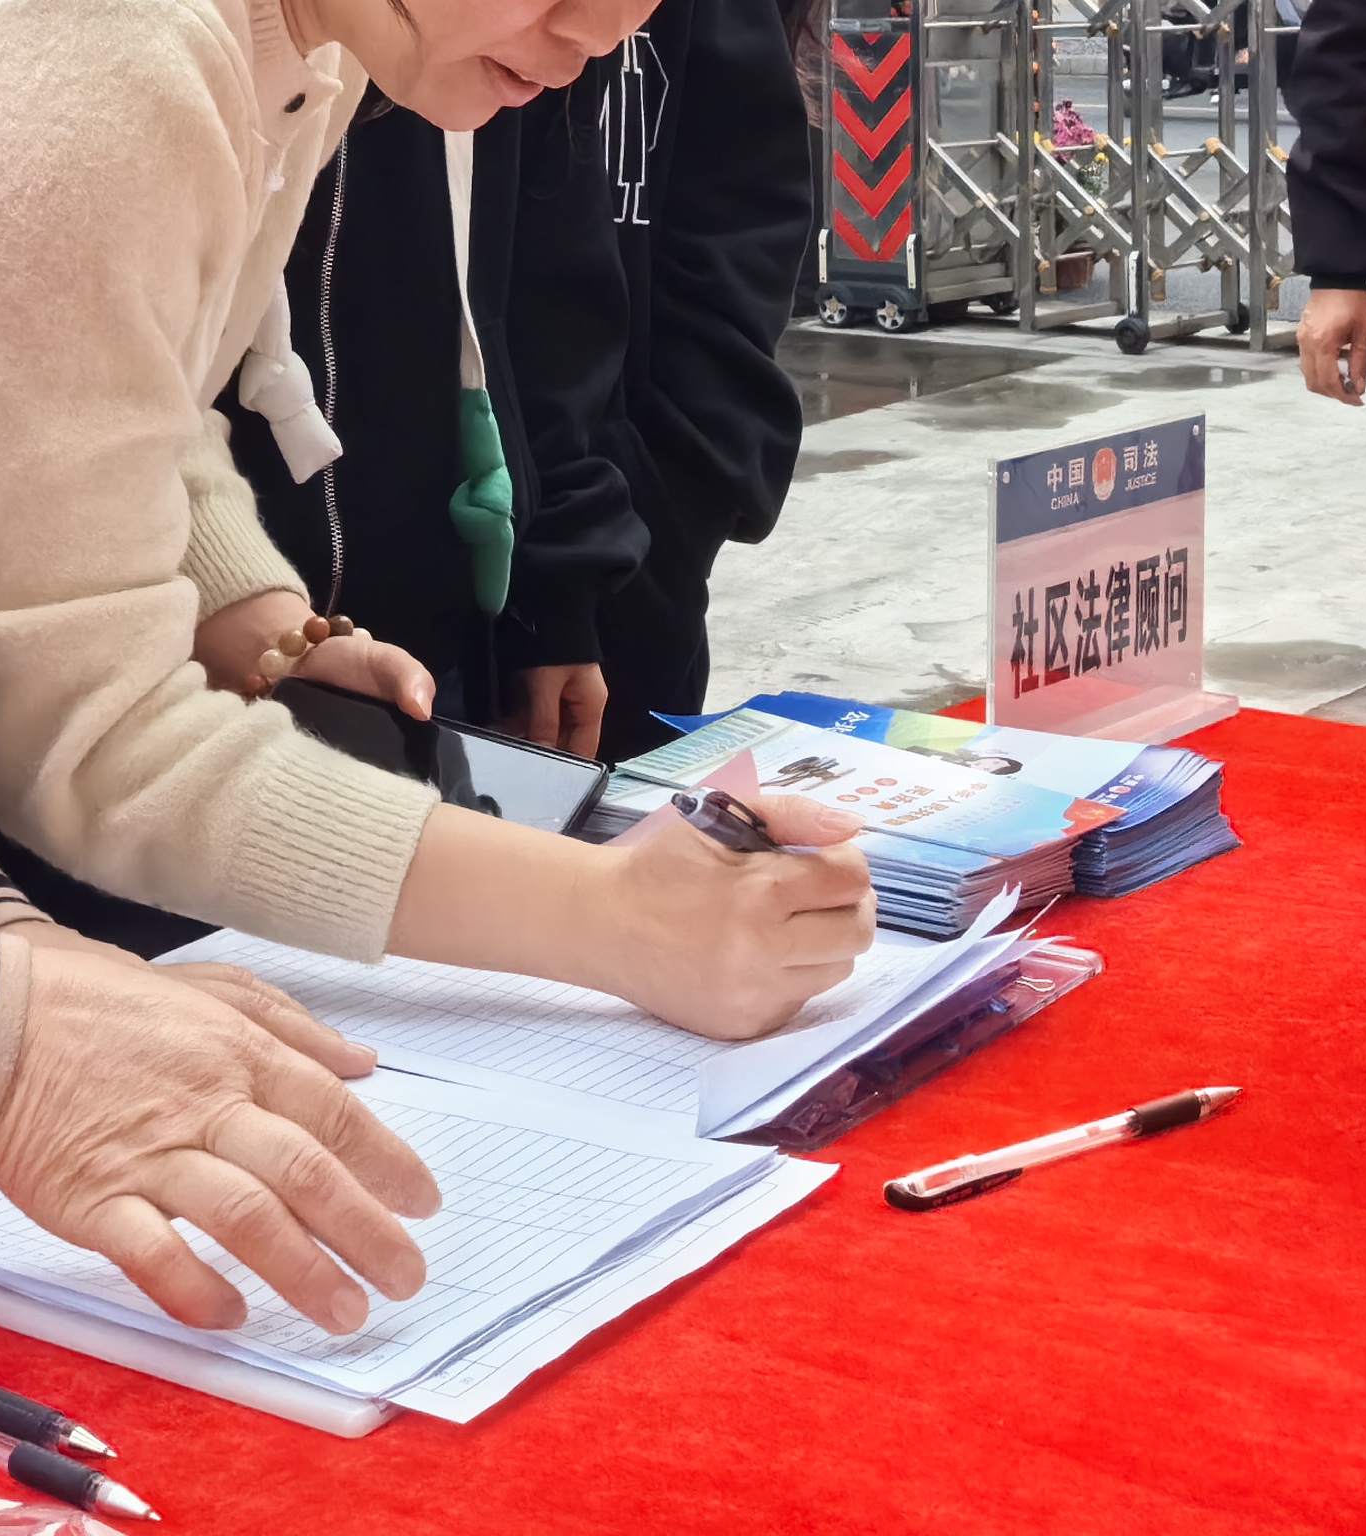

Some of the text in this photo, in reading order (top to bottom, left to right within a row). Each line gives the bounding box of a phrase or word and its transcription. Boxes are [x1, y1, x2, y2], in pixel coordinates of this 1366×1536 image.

[1047, 440, 1158, 493] 中国 司法
[1051, 472, 1157, 510] CHINA JUSTICE
[1010, 547, 1188, 699] 社区法律顾问
